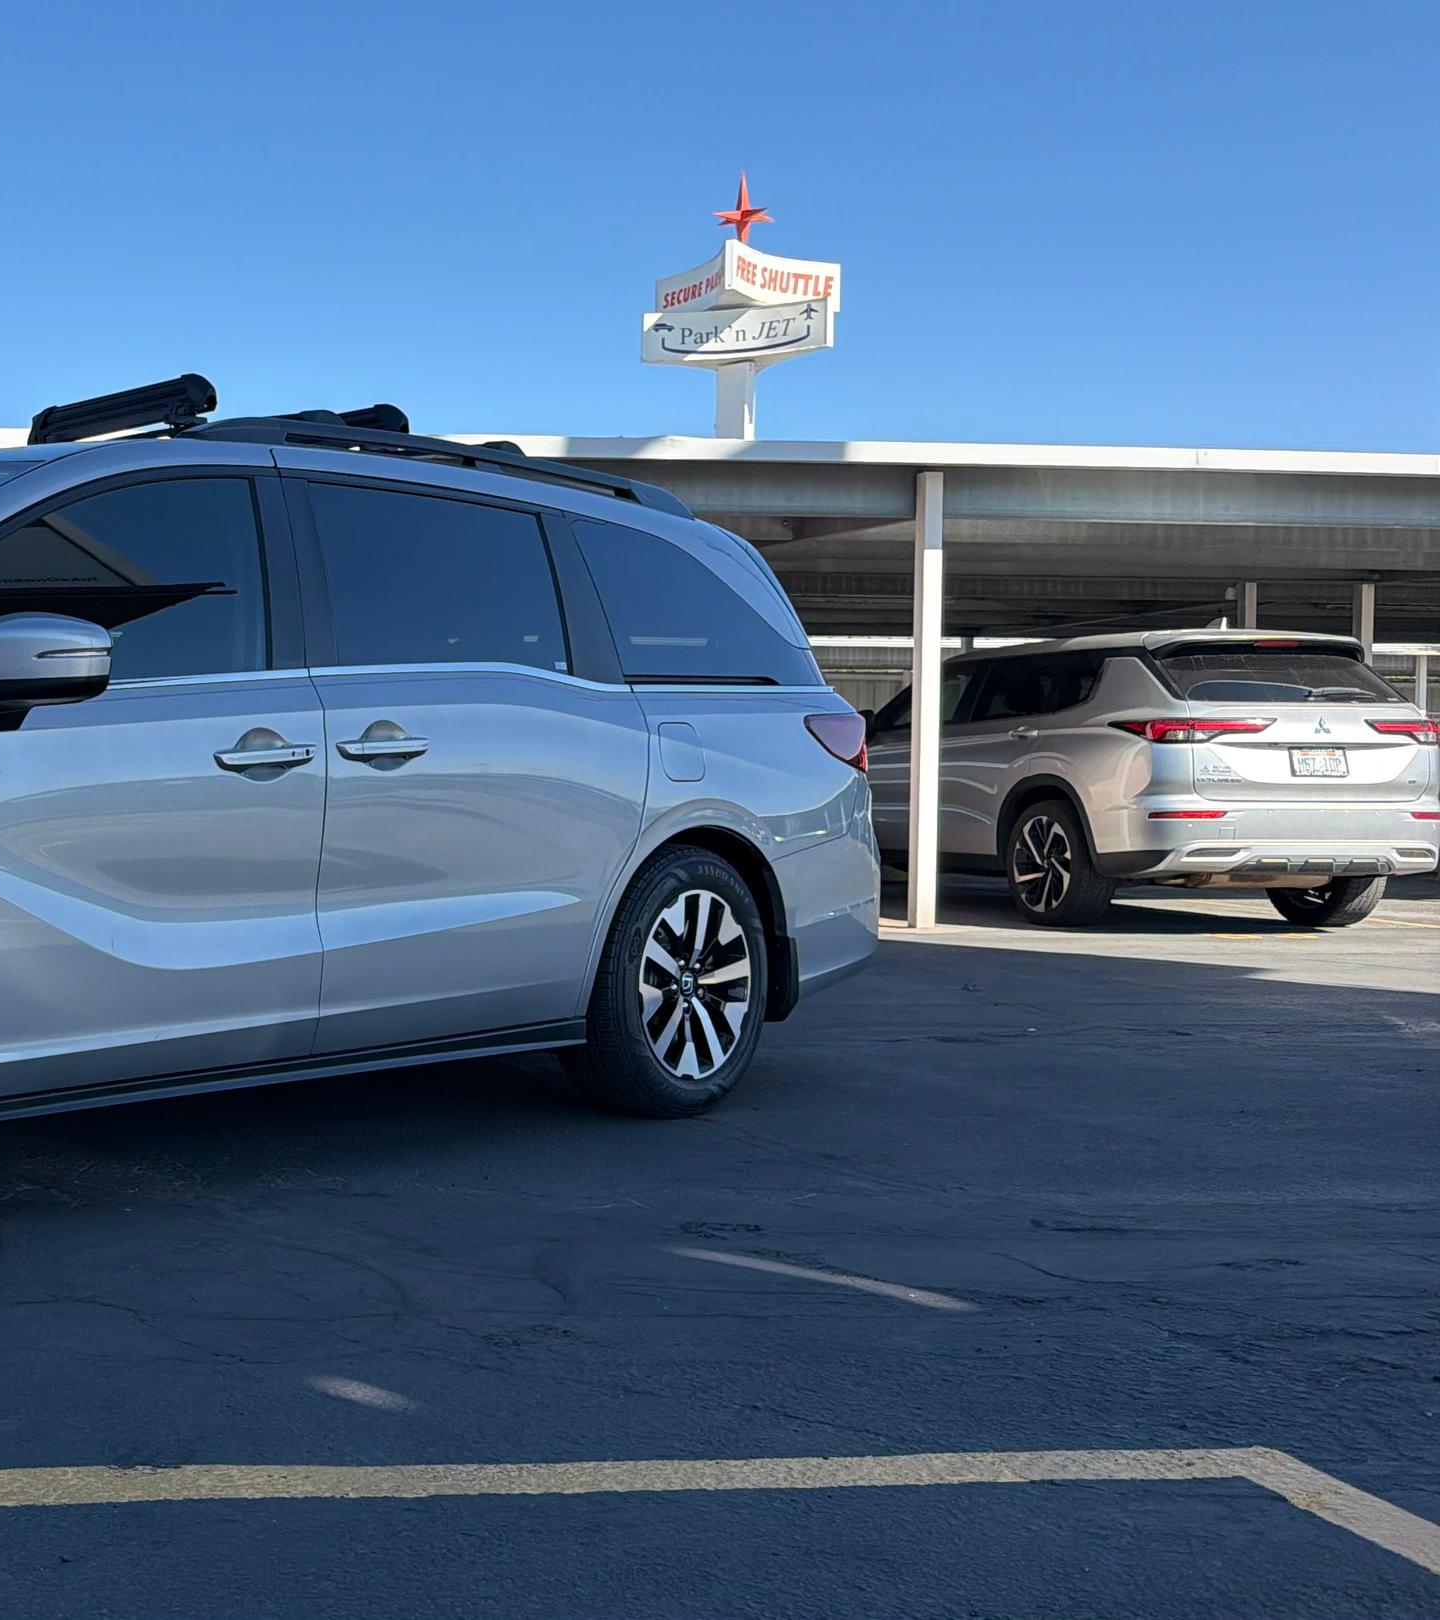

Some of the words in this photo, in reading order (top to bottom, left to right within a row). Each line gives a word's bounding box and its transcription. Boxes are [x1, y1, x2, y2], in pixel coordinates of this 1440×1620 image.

[736, 255, 757, 286] FREE
[760, 266, 834, 297] SHUTTLE
[662, 281, 703, 309] SECURE
[751, 317, 796, 341] JET
